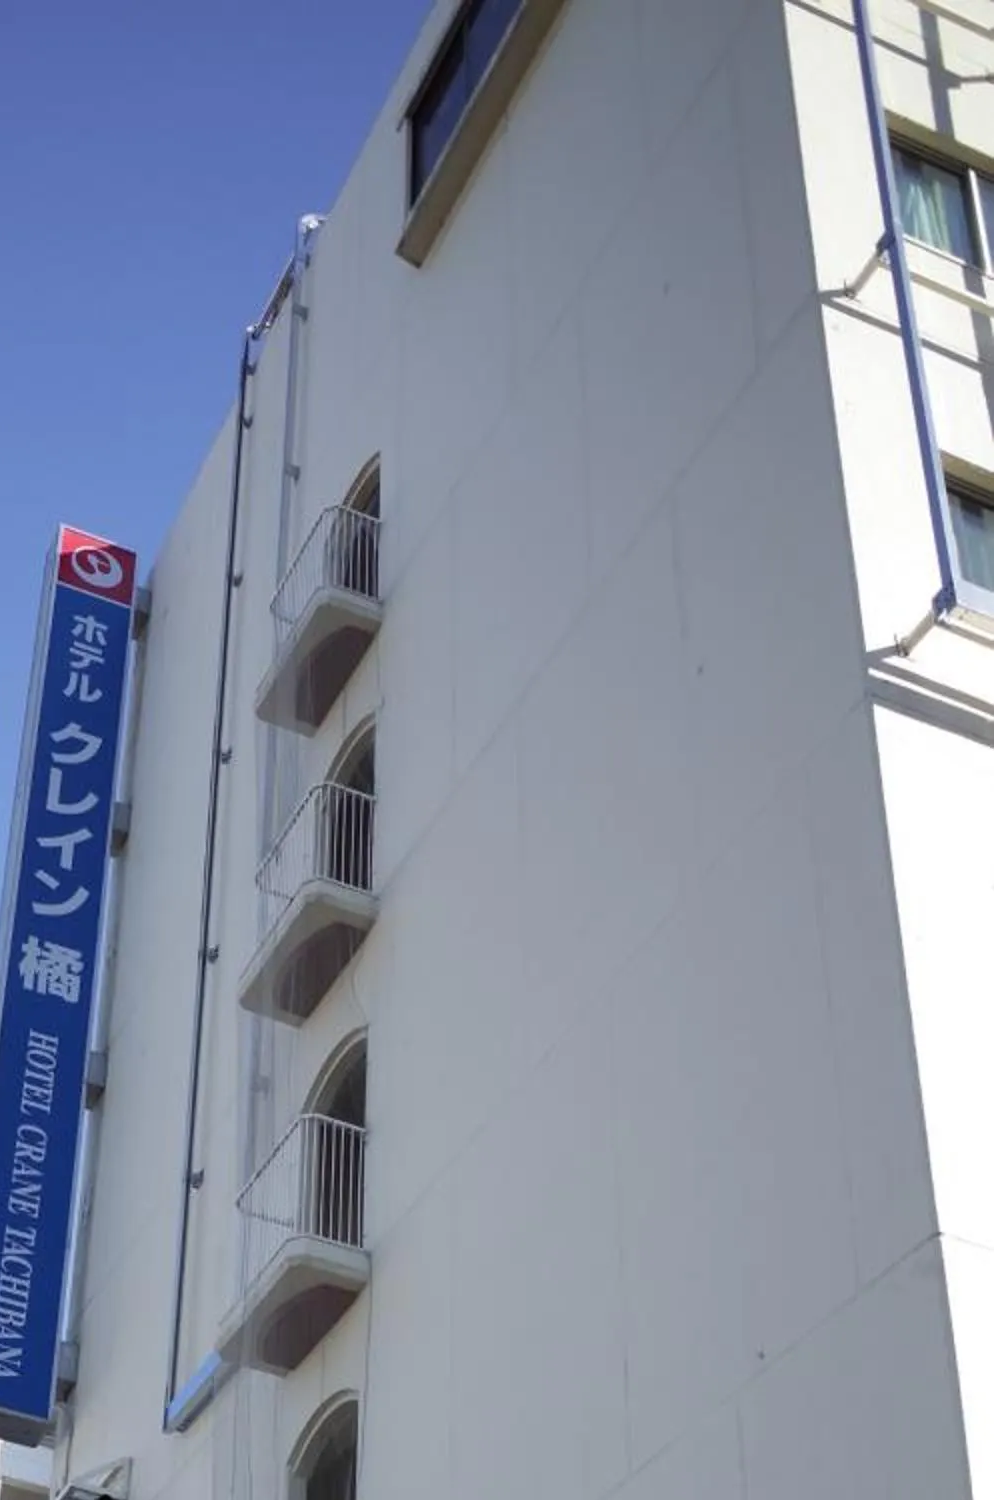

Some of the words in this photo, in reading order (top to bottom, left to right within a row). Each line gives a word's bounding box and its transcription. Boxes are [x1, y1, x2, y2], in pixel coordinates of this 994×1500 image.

[64, 614, 108, 702] ホテル
[31, 722, 103, 916] クレイン
[18, 935, 84, 1003] 橘
[20, 1029, 59, 1116] HOTEL
[8, 1123, 47, 1218] CRANE
